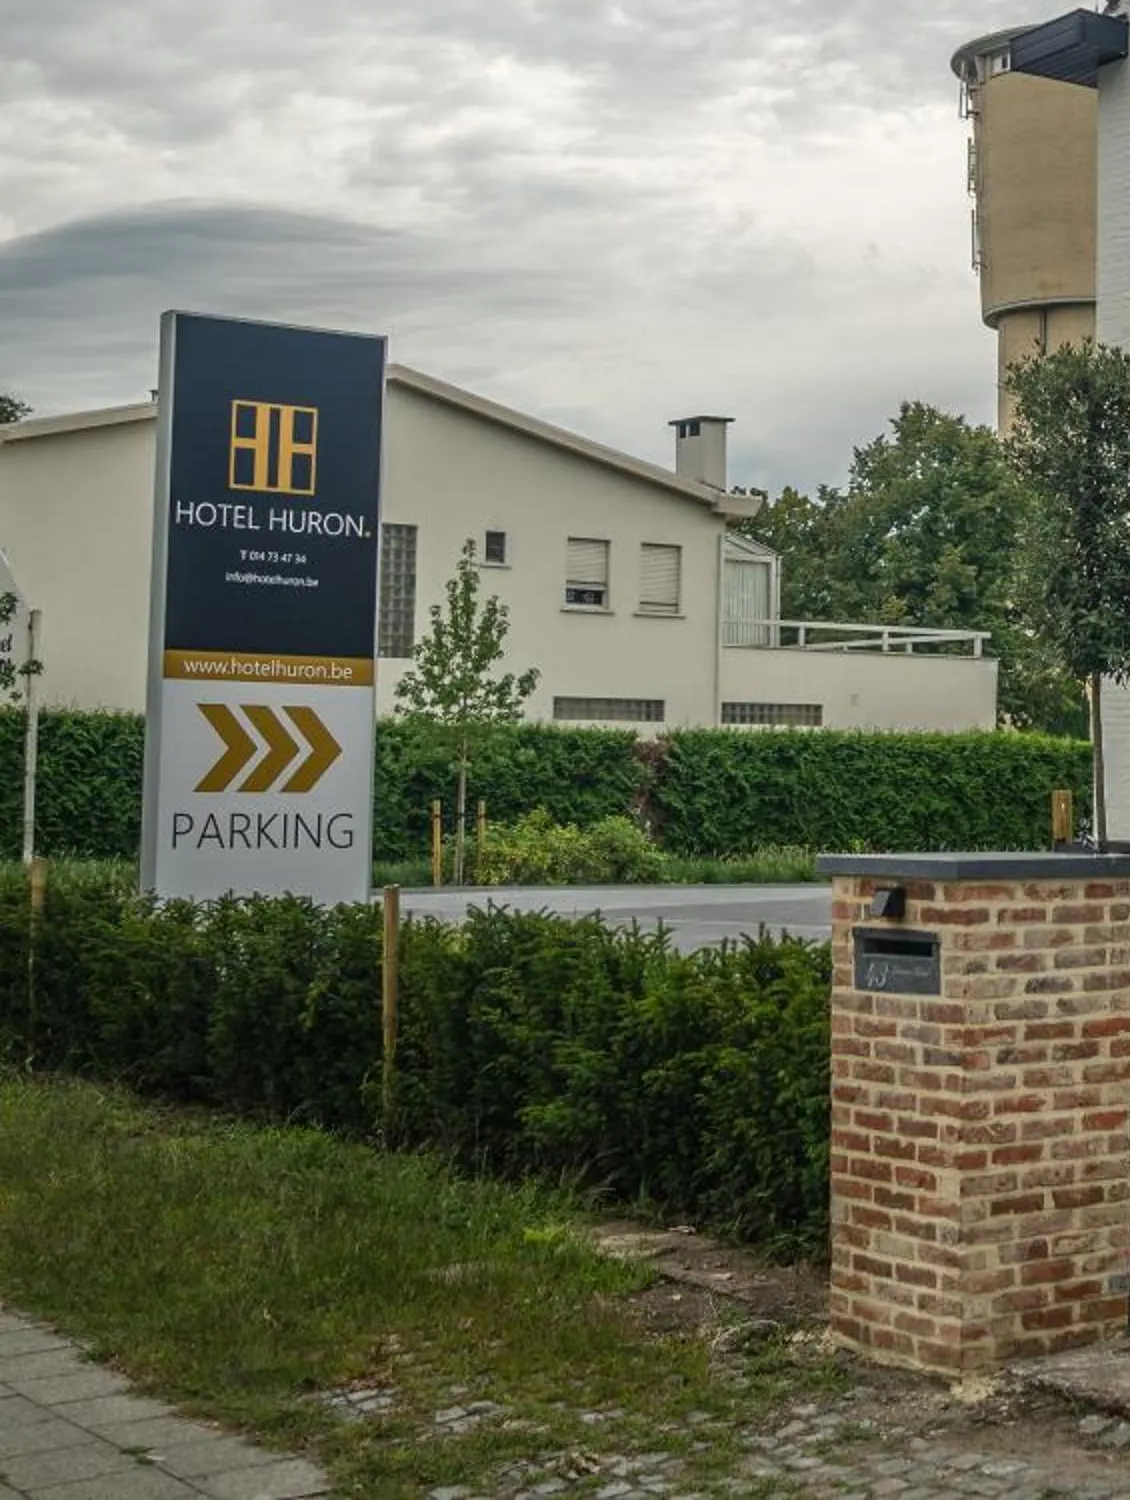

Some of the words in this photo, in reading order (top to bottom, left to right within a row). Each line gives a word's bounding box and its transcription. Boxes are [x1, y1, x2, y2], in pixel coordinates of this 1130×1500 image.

[175, 500, 260, 530] HOTEL
[267, 551, 279, 563] 73
[281, 553, 293, 564] 47
[224, 571, 319, 588] info@hotelhuron.be
[183, 657, 353, 679] www.hotelhuron.be
[172, 812, 353, 849] PARKING
